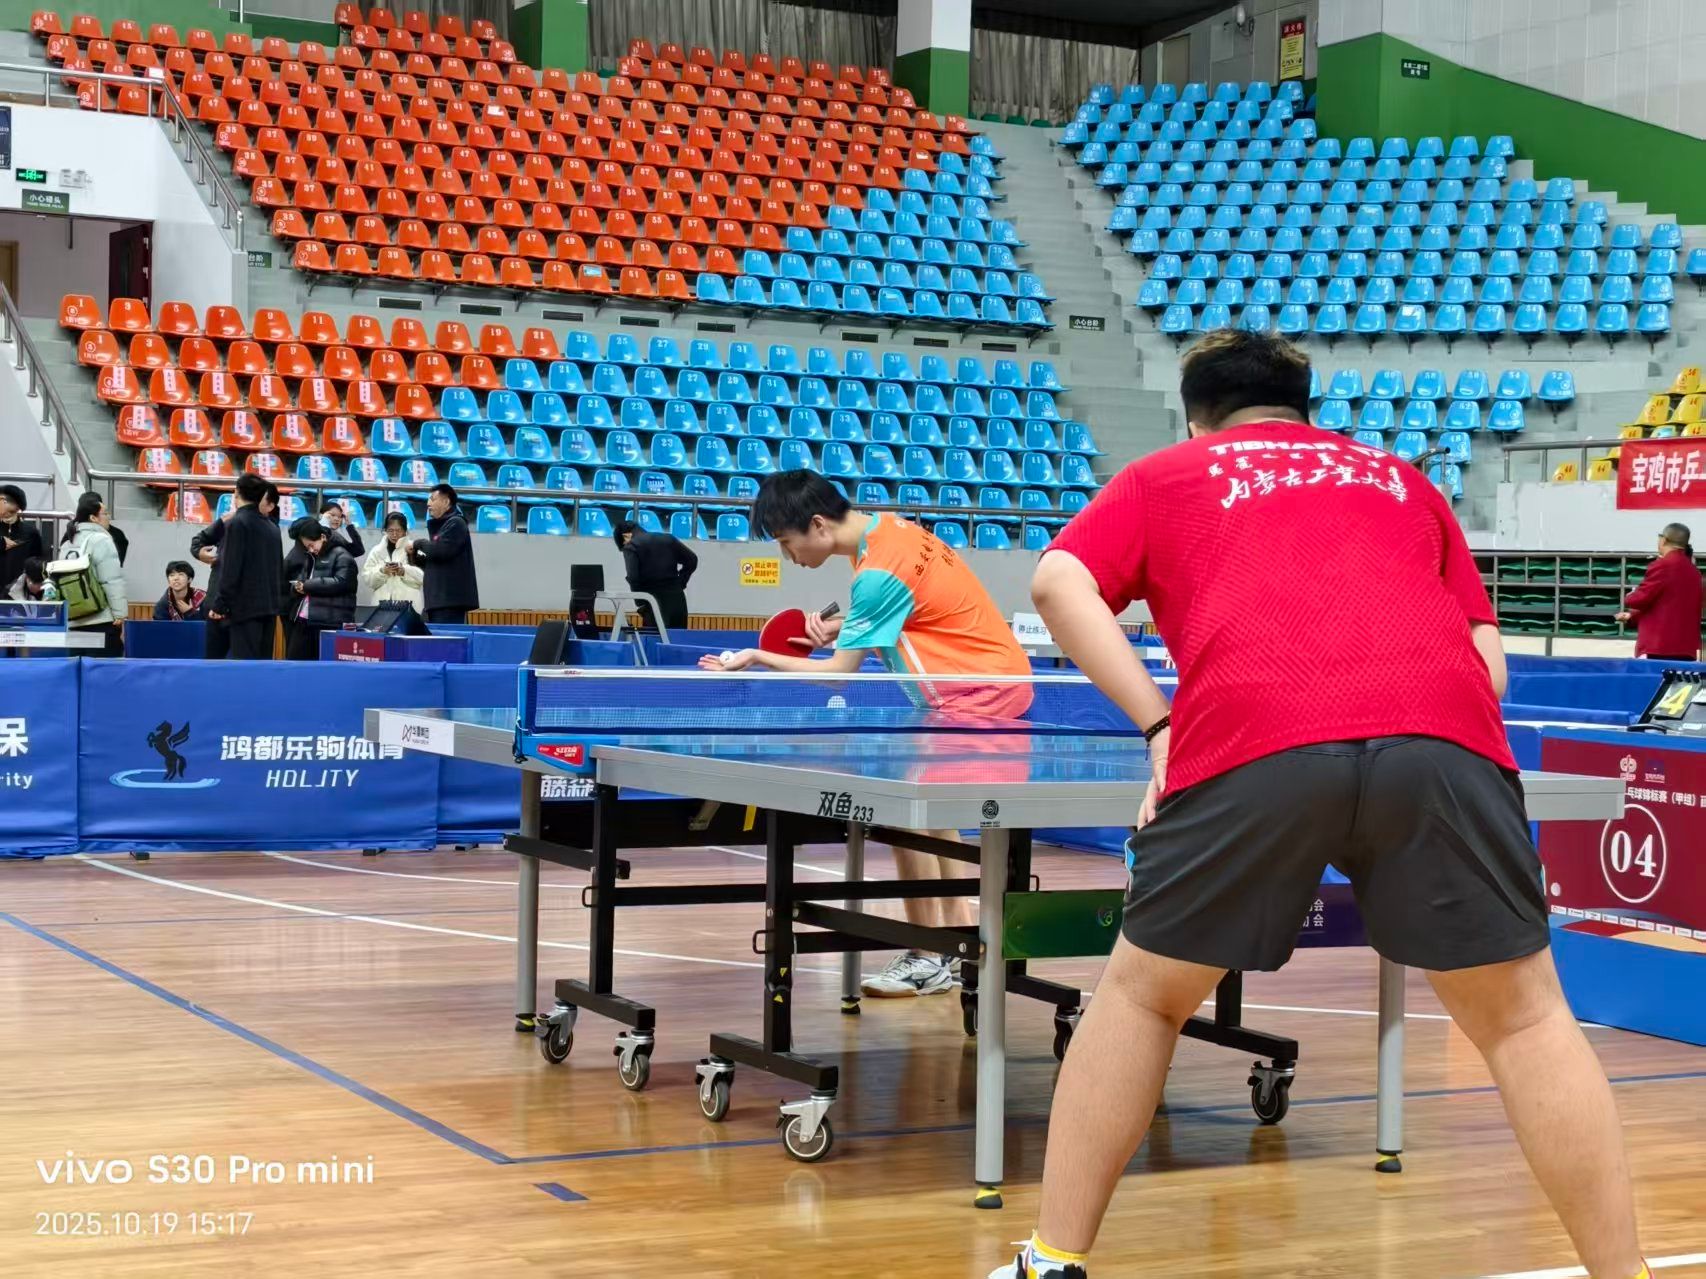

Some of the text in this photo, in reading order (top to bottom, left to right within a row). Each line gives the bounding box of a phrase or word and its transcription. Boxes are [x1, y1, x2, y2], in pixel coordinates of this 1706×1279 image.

[1018, 624, 1048, 635] 停止练习
[0, 772, 33, 789] ity
[817, 791, 874, 822] 双鱼 233
[1610, 830, 1657, 878] 04
